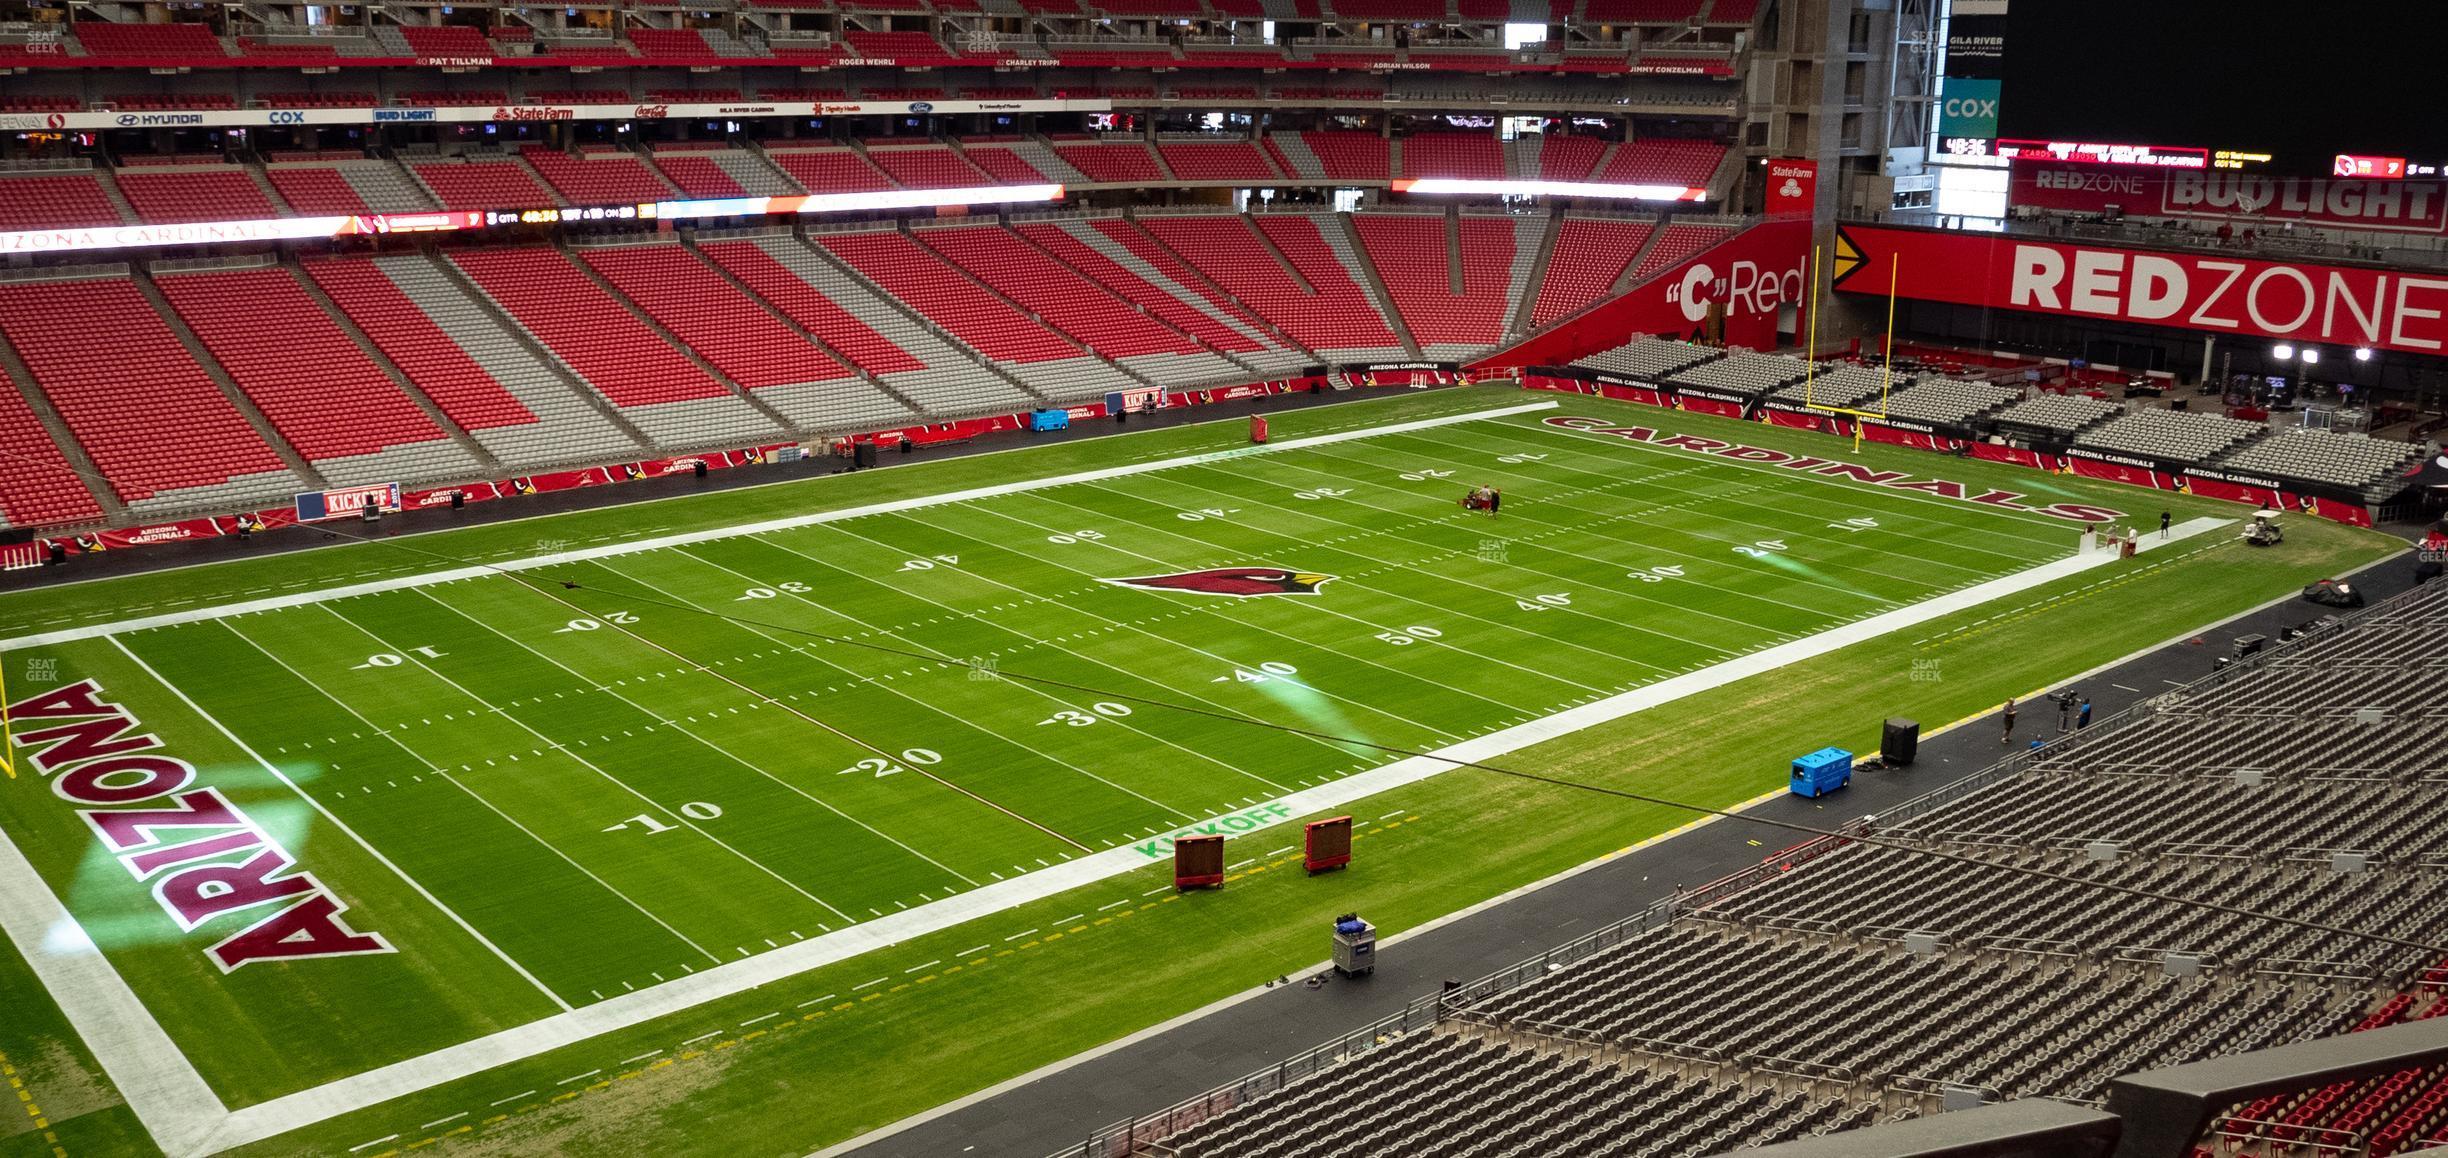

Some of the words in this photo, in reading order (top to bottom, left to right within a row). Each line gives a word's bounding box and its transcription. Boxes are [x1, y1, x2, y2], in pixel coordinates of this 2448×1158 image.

[1950, 37, 1973, 45] GILA
[1974, 37, 2003, 45] RIVER
[429, 58, 448, 66] PAT
[450, 58, 493, 66] TILLMAN
[1005, 59, 1036, 67] CHARLEY
[1630, 66, 1654, 74] JIMMY
[1656, 66, 1705, 74] CONZELMAN
[375, 110, 400, 121] BUD
[401, 110, 434, 121] LIGHT
[913, 103, 930, 113] Ford
[1945, 98, 1996, 118] COX
[143, 114, 203, 125] HYUNDAI
[269, 111, 304, 124] COX
[1946, 138, 1986, 155] 48:36
[2388, 162, 2399, 174] 7
[2036, 170, 2144, 194] REDZONE
[2172, 170, 2275, 211] BUD
[2281, 176, 2439, 220] LIGHT
[2010, 244, 2448, 350] REDZONE
[1369, 363, 1399, 371] ARIZONA
[1400, 362, 1439, 370] CARDINALS
[1597, 375, 1624, 386] ARIZONA
[1624, 378, 1659, 391] CARDINALS
[1677, 387, 1706, 398] ARIZONA
[1706, 391, 1744, 404] CARDINALS
[1763, 401, 1795, 413] ARIZONA
[1795, 405, 1836, 418] CARDINALS
[1858, 416, 1891, 427] ARIZONA
[1891, 419, 1934, 433] CARDINALS
[2065, 448, 2104, 460] ARIZONA
[2105, 453, 2155, 469] CARDINALS
[1540, 415, 2131, 524] CARDINALS
[2182, 467, 2225, 479] ARIZONA
[2226, 473, 2281, 488] CARDINALS
[1177, 508, 1225, 522] 40
[140, 525, 179, 536] ARIZONA
[1827, 518, 1879, 533] 10
[128, 528, 192, 545] CARDINALS
[1048, 529, 1107, 546] 50
[1732, 541, 1788, 557] 20
[902, 553, 960, 573] 40
[1627, 566, 1685, 583] 30
[744, 580, 813, 601] 30
[1516, 594, 1571, 612] 40
[566, 609, 640, 632] 20
[1375, 624, 1442, 647] 50
[366, 644, 450, 667] 10
[1234, 660, 1298, 684] 40
[1052, 701, 1132, 727] 30
[857, 747, 942, 779] 20
[0, 677, 400, 976] ARIZONA
[626, 801, 723, 835] 10
